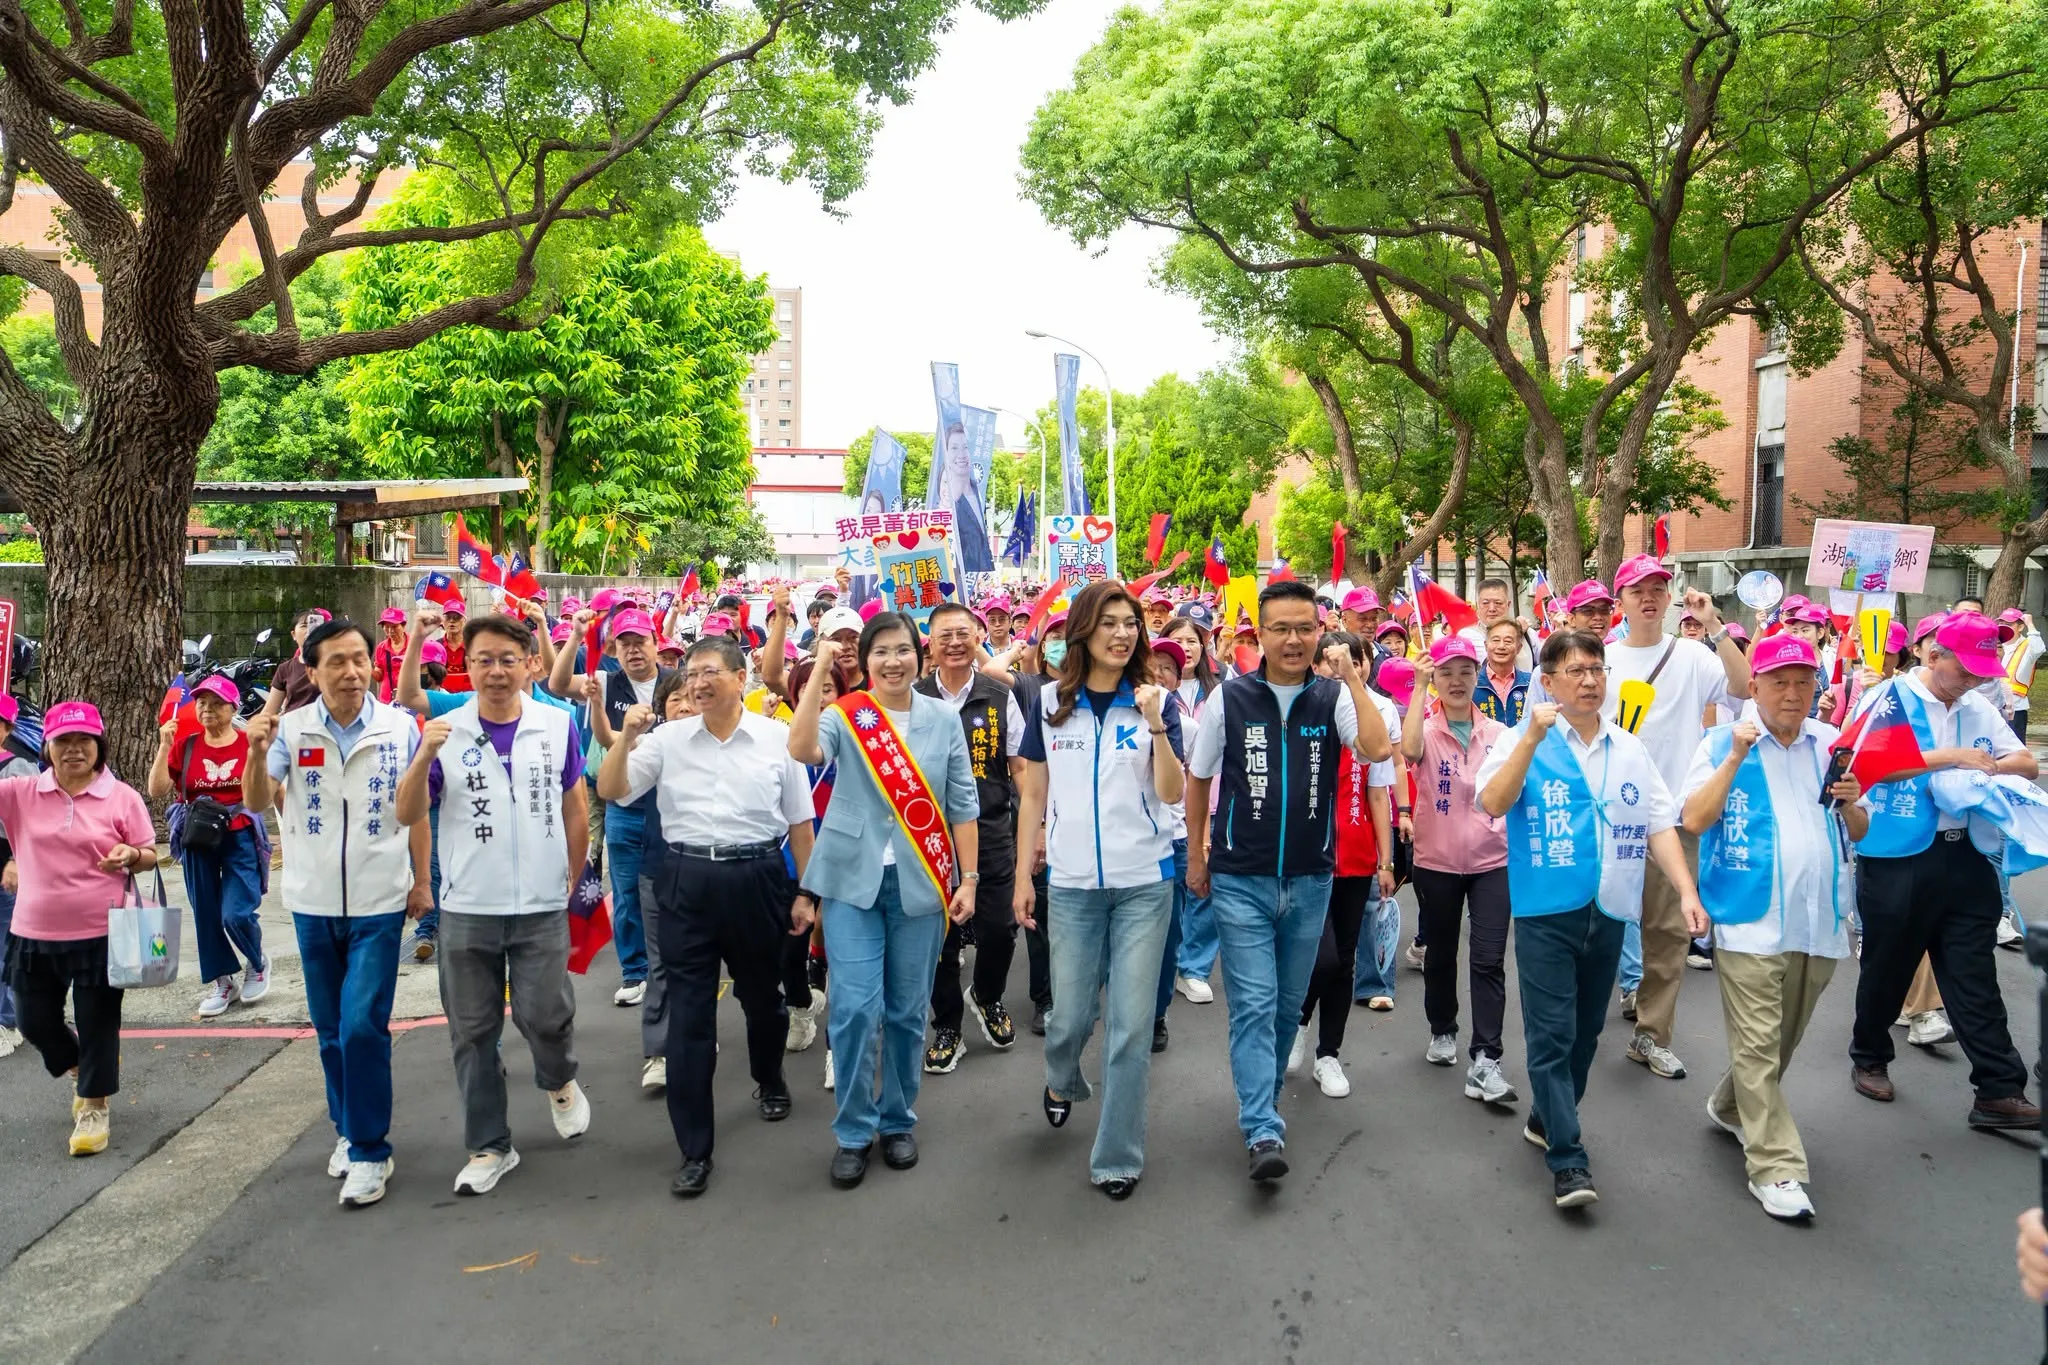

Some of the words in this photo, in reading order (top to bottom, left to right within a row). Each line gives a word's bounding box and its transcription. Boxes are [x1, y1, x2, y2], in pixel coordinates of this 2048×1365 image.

[889, 556, 943, 586] 竹縣
[1058, 542, 1105, 566] 票投
[894, 580, 946, 611] 共贏
[614, 701, 630, 712] KM
[1300, 725, 1328, 737] KMT
[1244, 726, 1269, 798] 吳旭智
[1308, 741, 1321, 819] 竹北市長候選人
[305, 770, 323, 835] 徐源發
[367, 776, 385, 836] 徐源發
[466, 770, 493, 844] 杜文中
[1252, 799, 1263, 820] 博士
[1435, 760, 1451, 816] 莊雅綺
[1526, 805, 1543, 868] 義工團隊
[1542, 778, 1577, 868] 徐欣瑩
[1612, 824, 1647, 840] 新竹要
[1616, 844, 1646, 861] 懇請支
